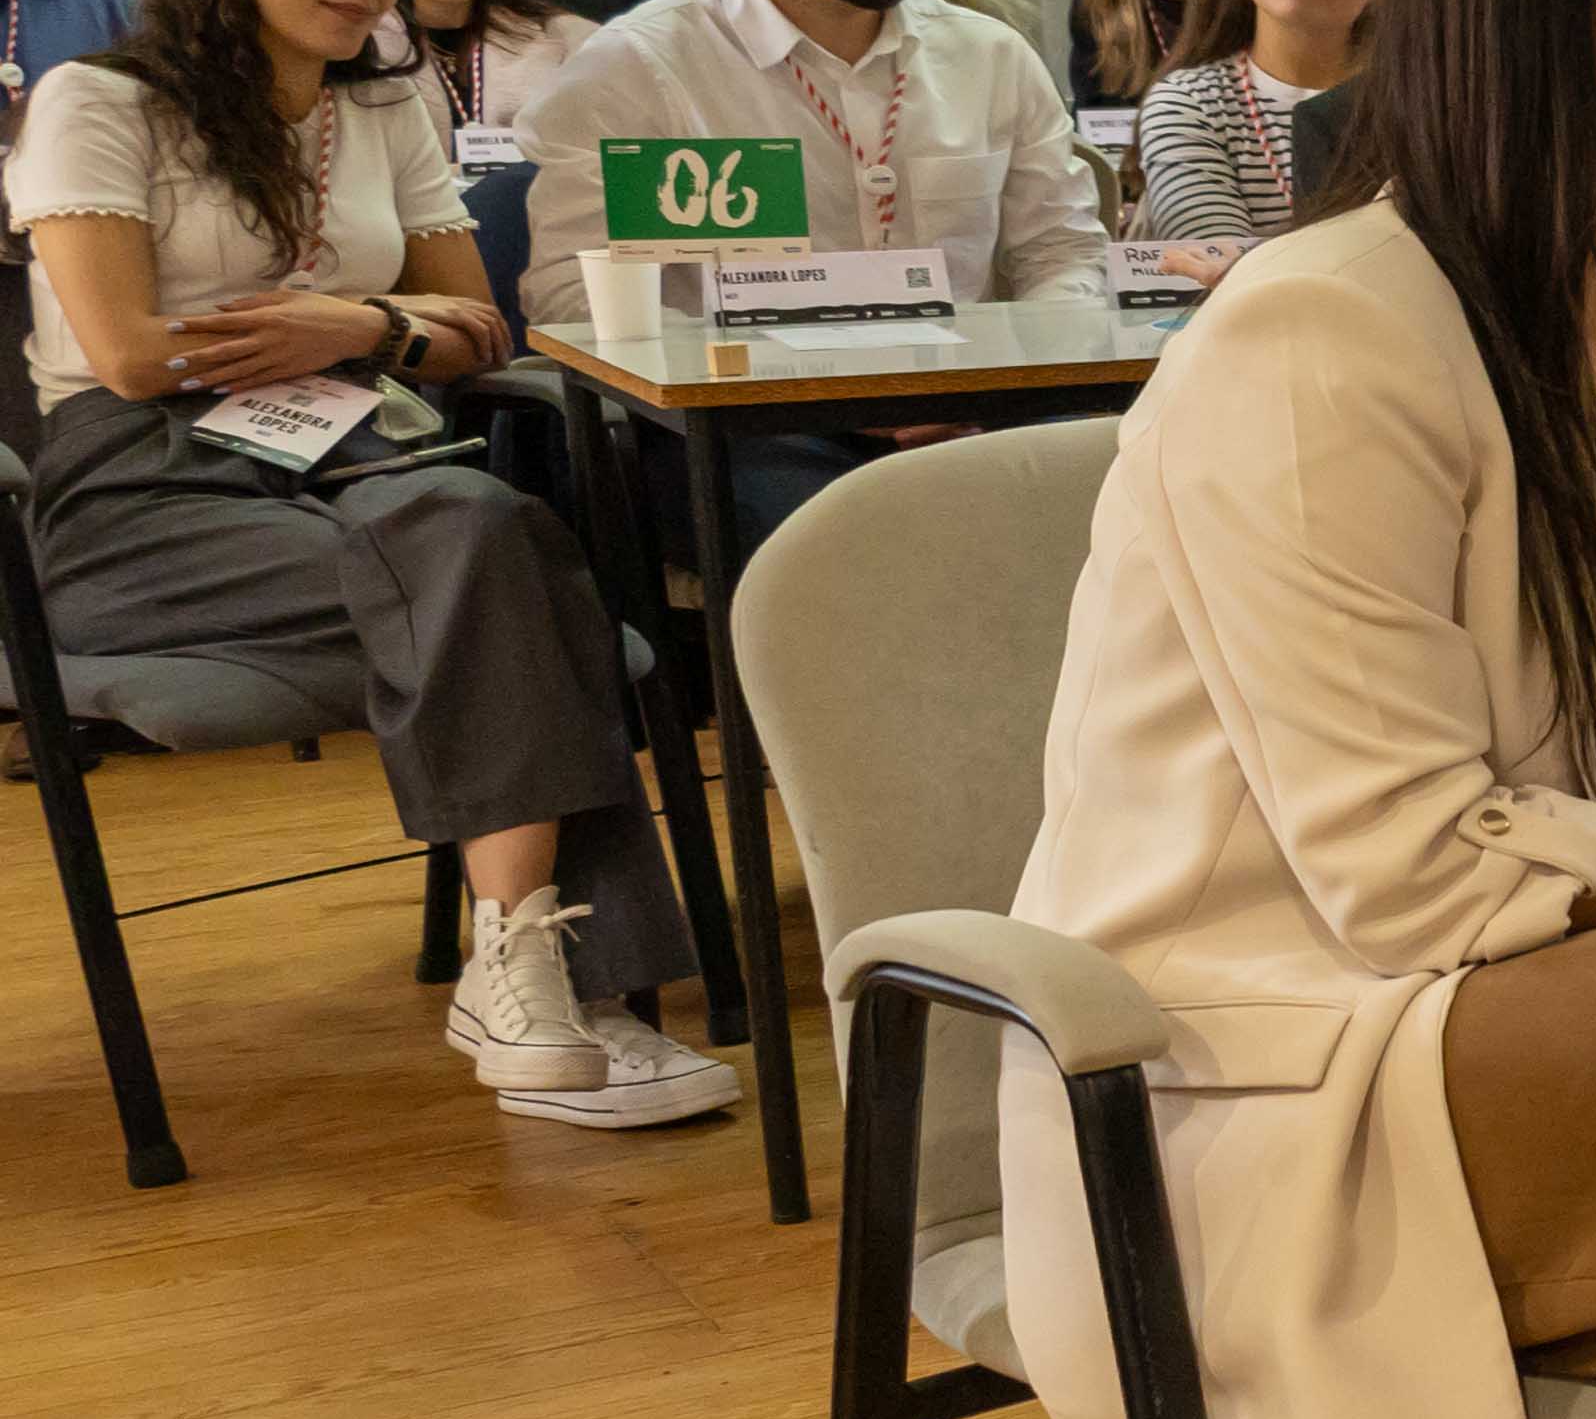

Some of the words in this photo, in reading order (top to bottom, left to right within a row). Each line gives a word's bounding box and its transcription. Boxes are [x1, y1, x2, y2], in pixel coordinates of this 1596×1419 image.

[657, 148, 758, 228] 06
[722, 270, 788, 284] ALEXANDRA
[791, 268, 827, 282] LOPES
[238, 398, 334, 432] ALEXANDRA
[248, 413, 303, 435] LOPES
